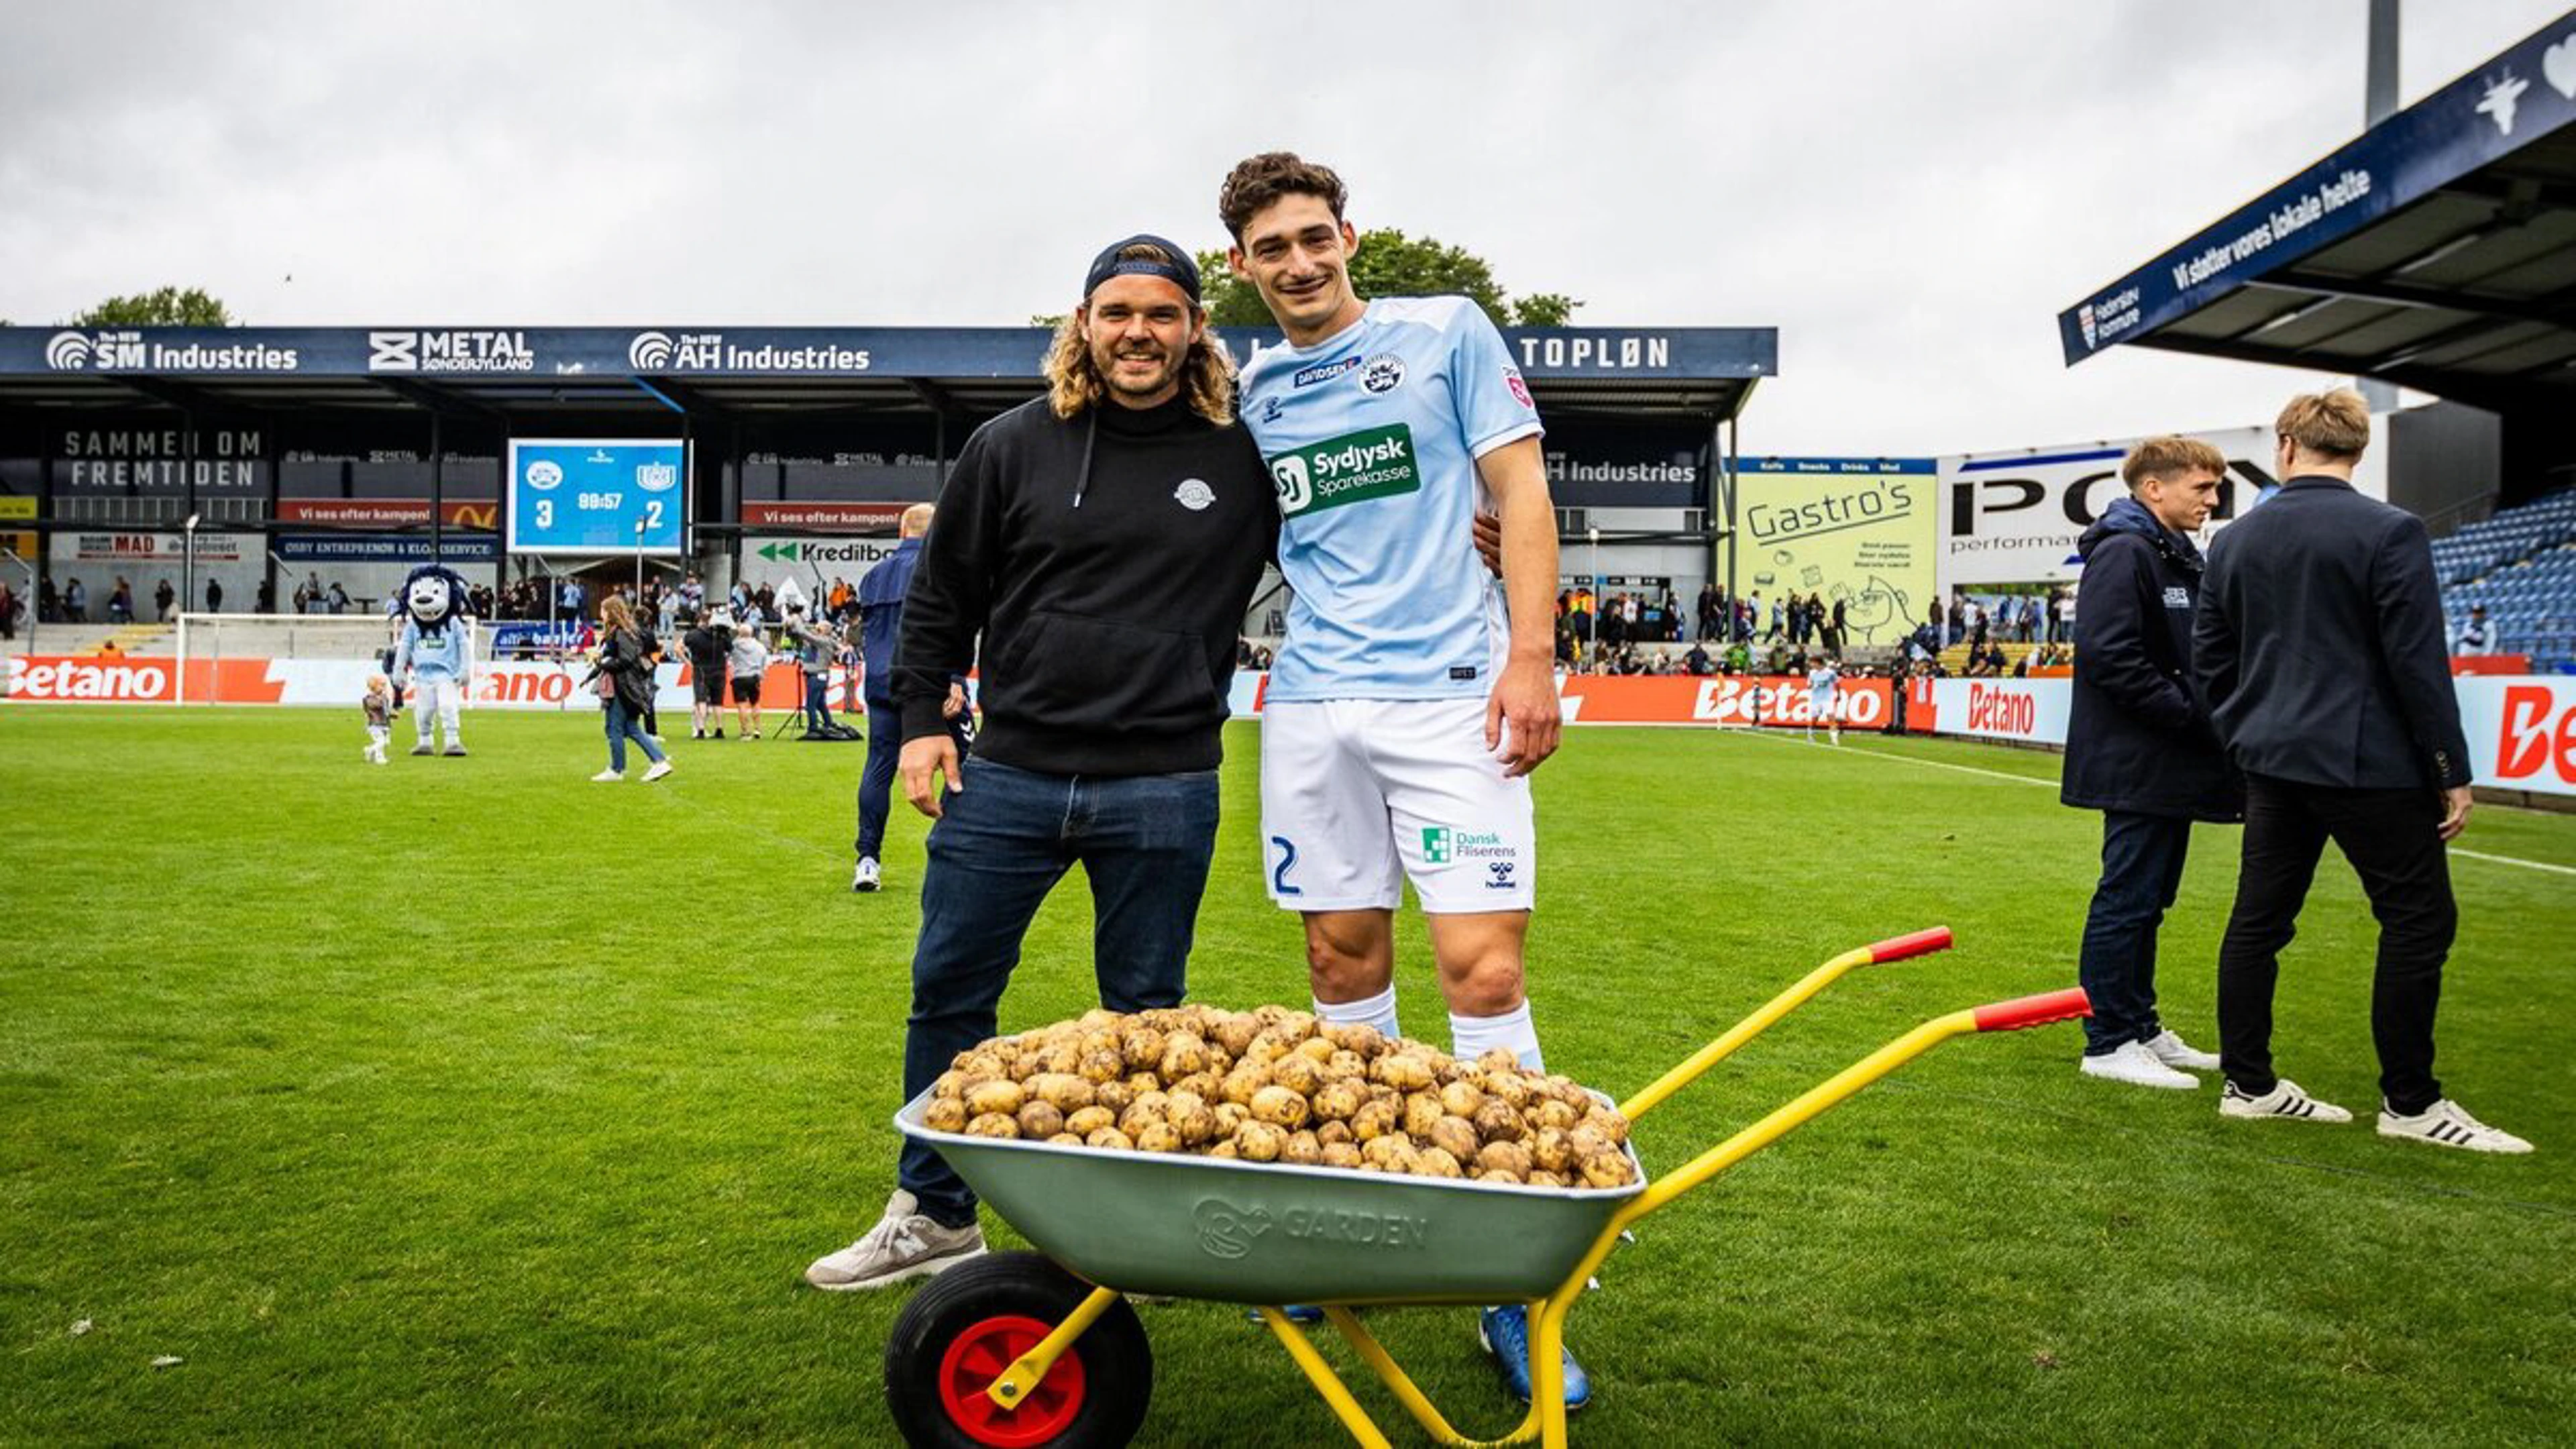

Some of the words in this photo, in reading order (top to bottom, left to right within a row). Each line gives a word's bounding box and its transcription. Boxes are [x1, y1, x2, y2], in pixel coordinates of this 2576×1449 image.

[2232, 223, 2273, 261] vores
[2269, 195, 2322, 239] lokale
[2320, 170, 2371, 213] helte
[154, 343, 297, 368] Industries
[422, 333, 533, 357] METAL
[728, 345, 869, 368] Industries
[1519, 338, 1668, 367] TOPLØN
[218, 431, 260, 455] OM
[1313, 437, 1407, 476] Sydjysk
[71, 462, 253, 485] FREMTIDEN
[1317, 465, 1411, 496] Sparekasse
[1572, 462, 1696, 482] Industries
[300, 508, 313, 520] Vi
[315, 511, 337, 520] ses
[340, 508, 370, 520] efter
[374, 508, 430, 523] kampen!
[536, 500, 553, 528] 3
[646, 500, 663, 528] 2
[764, 512, 777, 523] Vi
[780, 514, 803, 523] ses
[806, 512, 839, 523] efter
[841, 512, 899, 525] kampen!
[1748, 480, 1911, 537] Gastro's
[115, 536, 155, 552] MAD
[1950, 534, 2080, 554] performa
[1970, 683, 2033, 734] Betano
[1457, 833, 1501, 845] Dansk
[1457, 845, 1517, 857] Fliserens
[1272, 836, 1300, 894] 2
[1285, 1207, 1428, 1247] GARDEN
